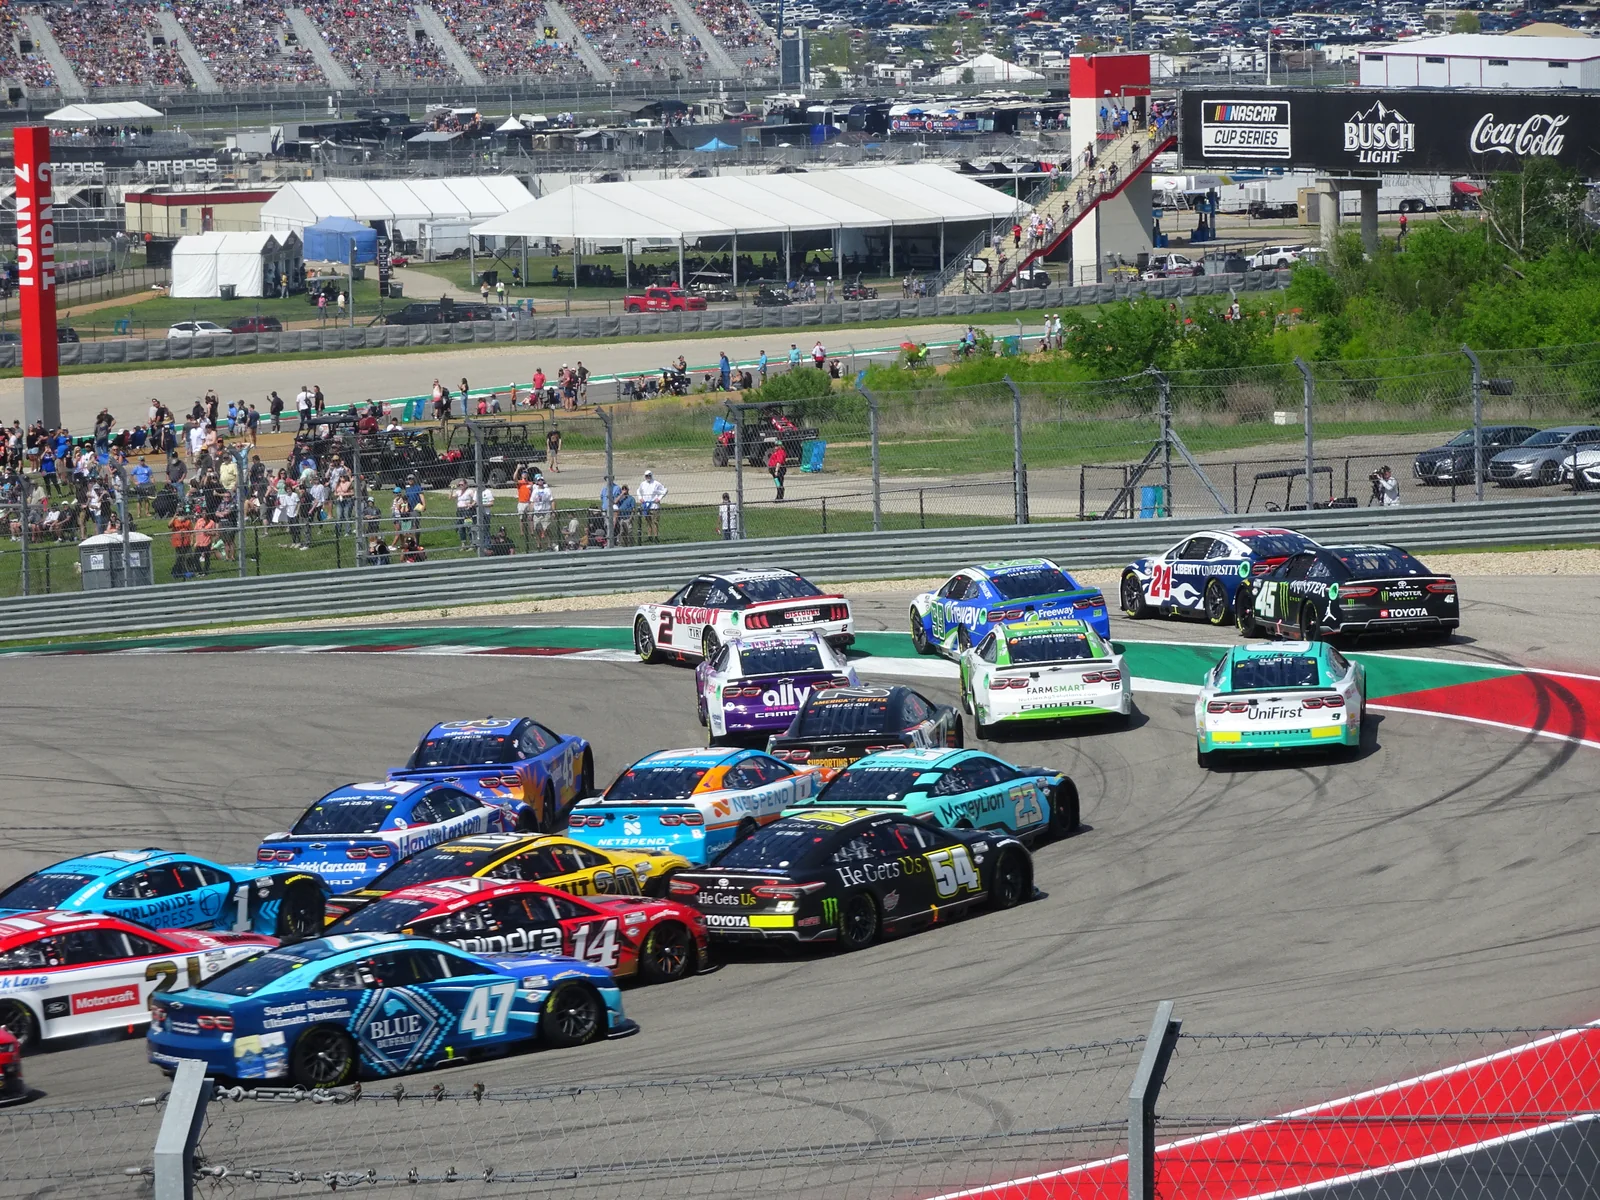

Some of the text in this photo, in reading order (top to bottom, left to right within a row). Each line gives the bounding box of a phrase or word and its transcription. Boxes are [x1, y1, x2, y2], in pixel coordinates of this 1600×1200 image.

[1230, 105, 1278, 121] NASCAR
[1214, 129, 1279, 145] CUP SERIES
[1344, 122, 1416, 152] BUSCH
[1470, 113, 1570, 157] Coca-Cola
[1359, 150, 1400, 163] LIGHT
[1174, 563, 1201, 576] LIBERTY
[1150, 564, 1172, 599] 24
[1254, 581, 1278, 617] 45
[1444, 594, 1455, 604] 45
[675, 606, 720, 625] DISCOUNT
[785, 609, 820, 620] DISCOUNT
[1038, 607, 1075, 619] Freeway
[1389, 607, 1429, 618] TOYOTA
[930, 600, 946, 641] 99
[657, 610, 674, 646] 2
[841, 624, 848, 633] 2
[1027, 684, 1087, 695] FARMSMART
[1110, 682, 1121, 691] 16
[762, 684, 811, 709] ally
[1021, 700, 1094, 710] CAMARO
[755, 711, 799, 719] CAMA
[1247, 706, 1303, 720] UniFirst
[1331, 713, 1341, 721] 9
[1241, 728, 1311, 736] CAMARO
[562, 746, 574, 789] 43
[807, 758, 848, 768] SUPPORTING
[732, 788, 790, 813] NETSPEND
[1008, 782, 1043, 829] 23
[940, 791, 1006, 825] MoneyLion
[598, 837, 667, 846] NETSPEND
[375, 862, 388, 873] 5
[836, 866, 866, 888] He
[865, 861, 900, 882] Gets
[922, 844, 982, 899] 54
[698, 892, 756, 906] He Gets Us
[232, 885, 252, 933] 1
[775, 900, 796, 913] 54
[145, 908, 195, 930] XPRESS
[705, 915, 749, 927] TOYOTA
[571, 917, 621, 969] 14
[13, 976, 49, 988] Lane
[76, 990, 136, 1010] Motorcraft
[263, 1003, 307, 1017] Superior
[459, 981, 518, 1039] 47
[263, 1016, 307, 1029] Ultimate
[369, 1014, 422, 1040] BLUE
[376, 1034, 420, 1049] BUFFALO
